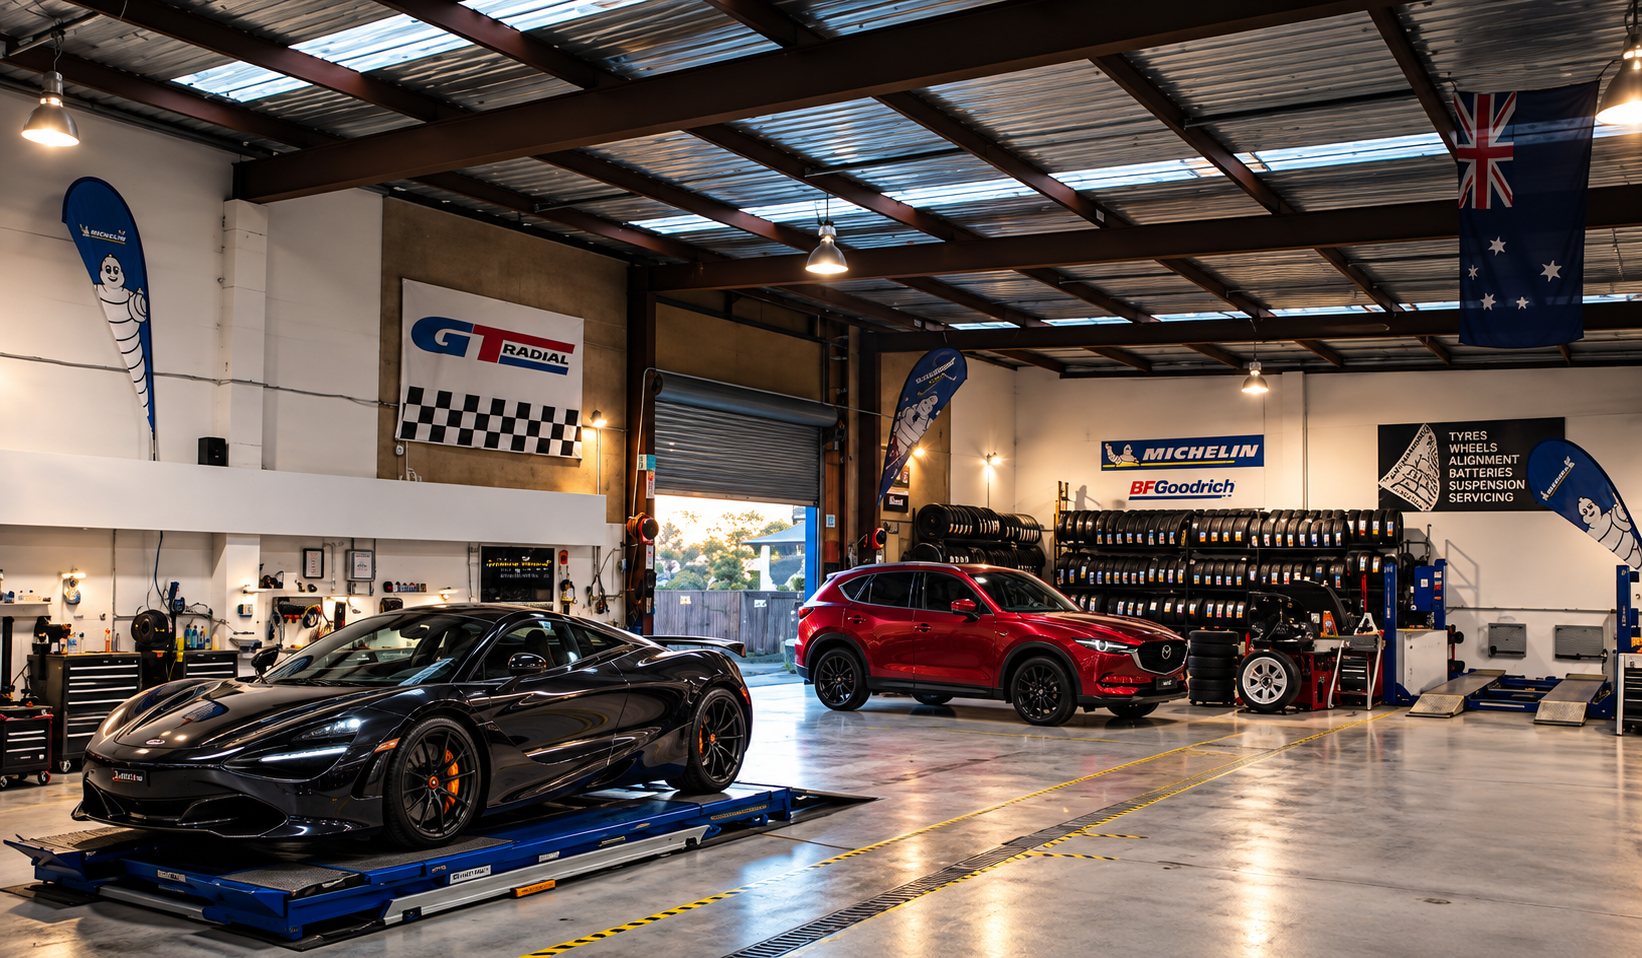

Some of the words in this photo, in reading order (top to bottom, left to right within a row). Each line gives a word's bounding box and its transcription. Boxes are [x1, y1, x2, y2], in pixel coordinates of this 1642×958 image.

[411, 316, 575, 363] GT
[502, 343, 569, 365] RADIAL
[1448, 430, 1488, 441] TYRES
[1142, 444, 1259, 461] MICHELIN
[1449, 442, 1498, 454] WHEELS
[1448, 454, 1520, 466] ALIGNMENT
[1448, 467, 1513, 479] BATTERIES
[1129, 479, 1235, 494] BFGoodrich
[1448, 479, 1526, 491] SUSPENSION
[1448, 491, 1514, 503] SERVICING
